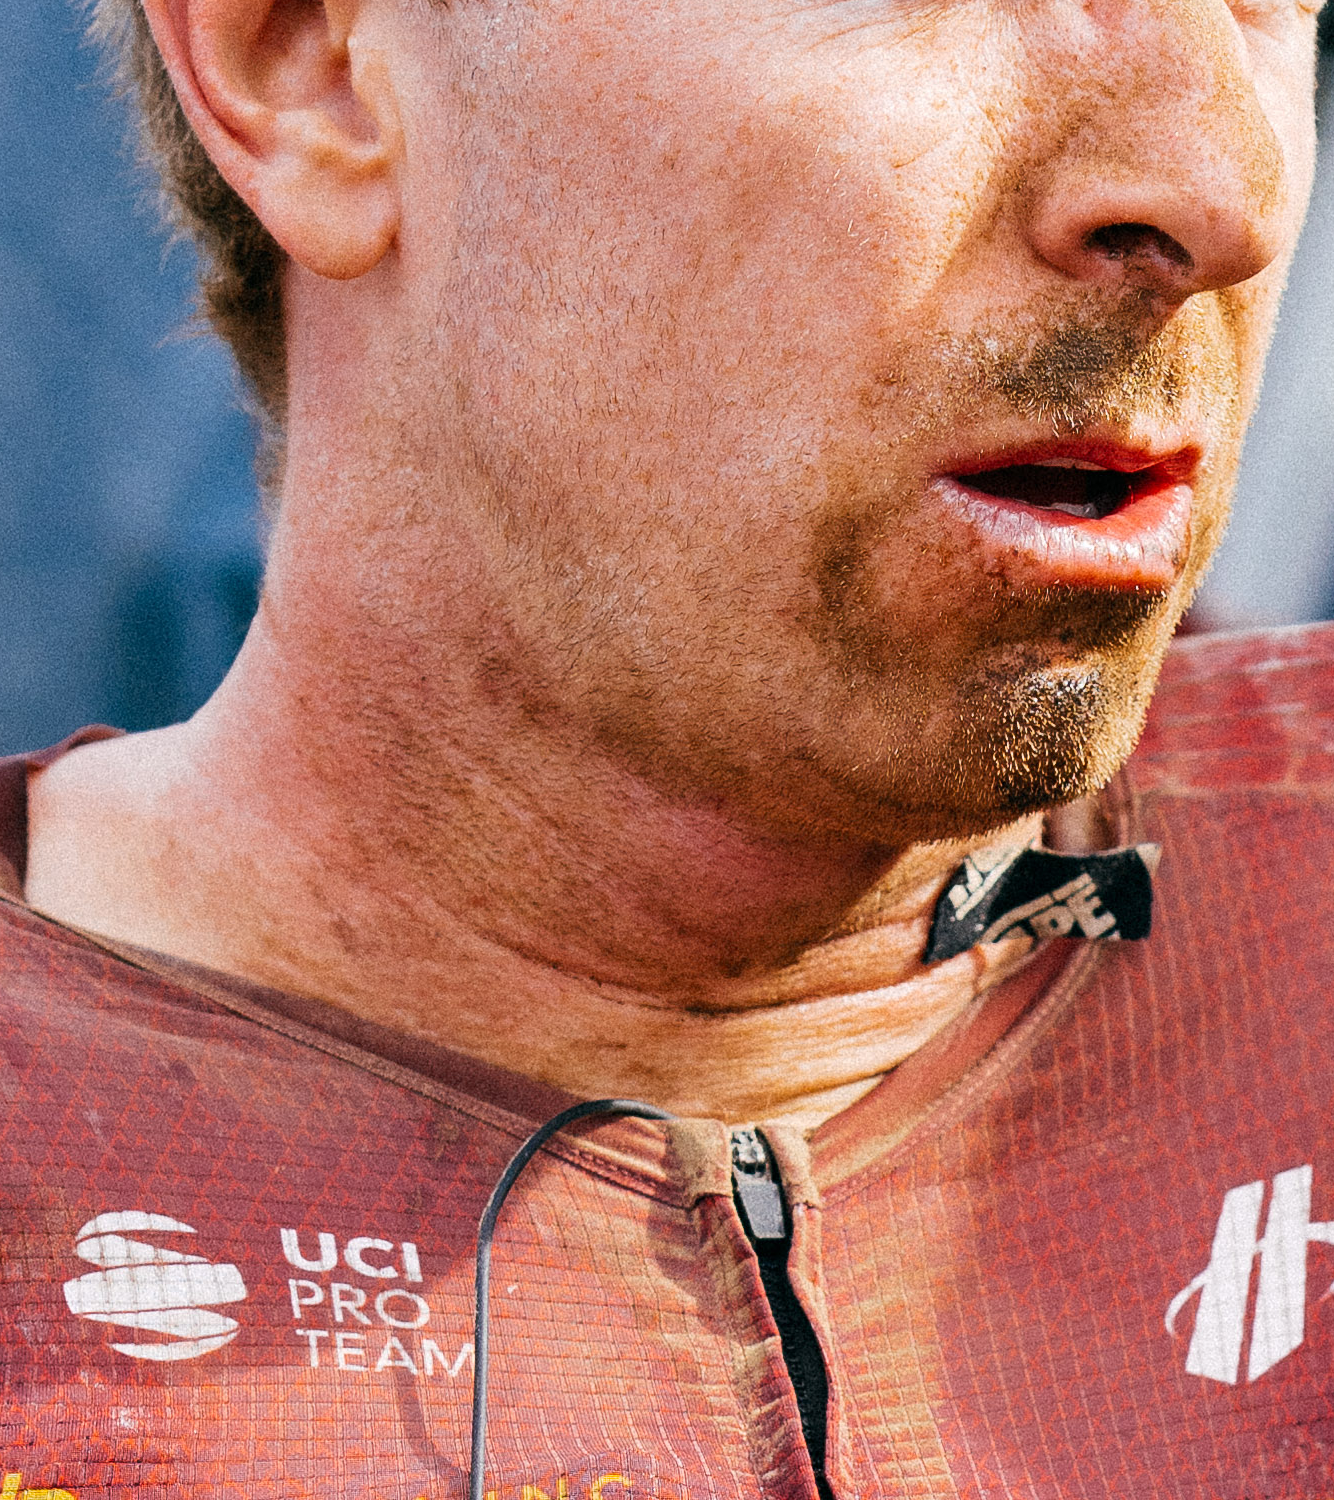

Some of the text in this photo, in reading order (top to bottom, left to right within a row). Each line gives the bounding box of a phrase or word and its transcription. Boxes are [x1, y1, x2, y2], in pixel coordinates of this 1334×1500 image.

[280, 1227, 424, 1279] UCI
[289, 1277, 430, 1330] PRO
[296, 1327, 474, 1378] TEAM
